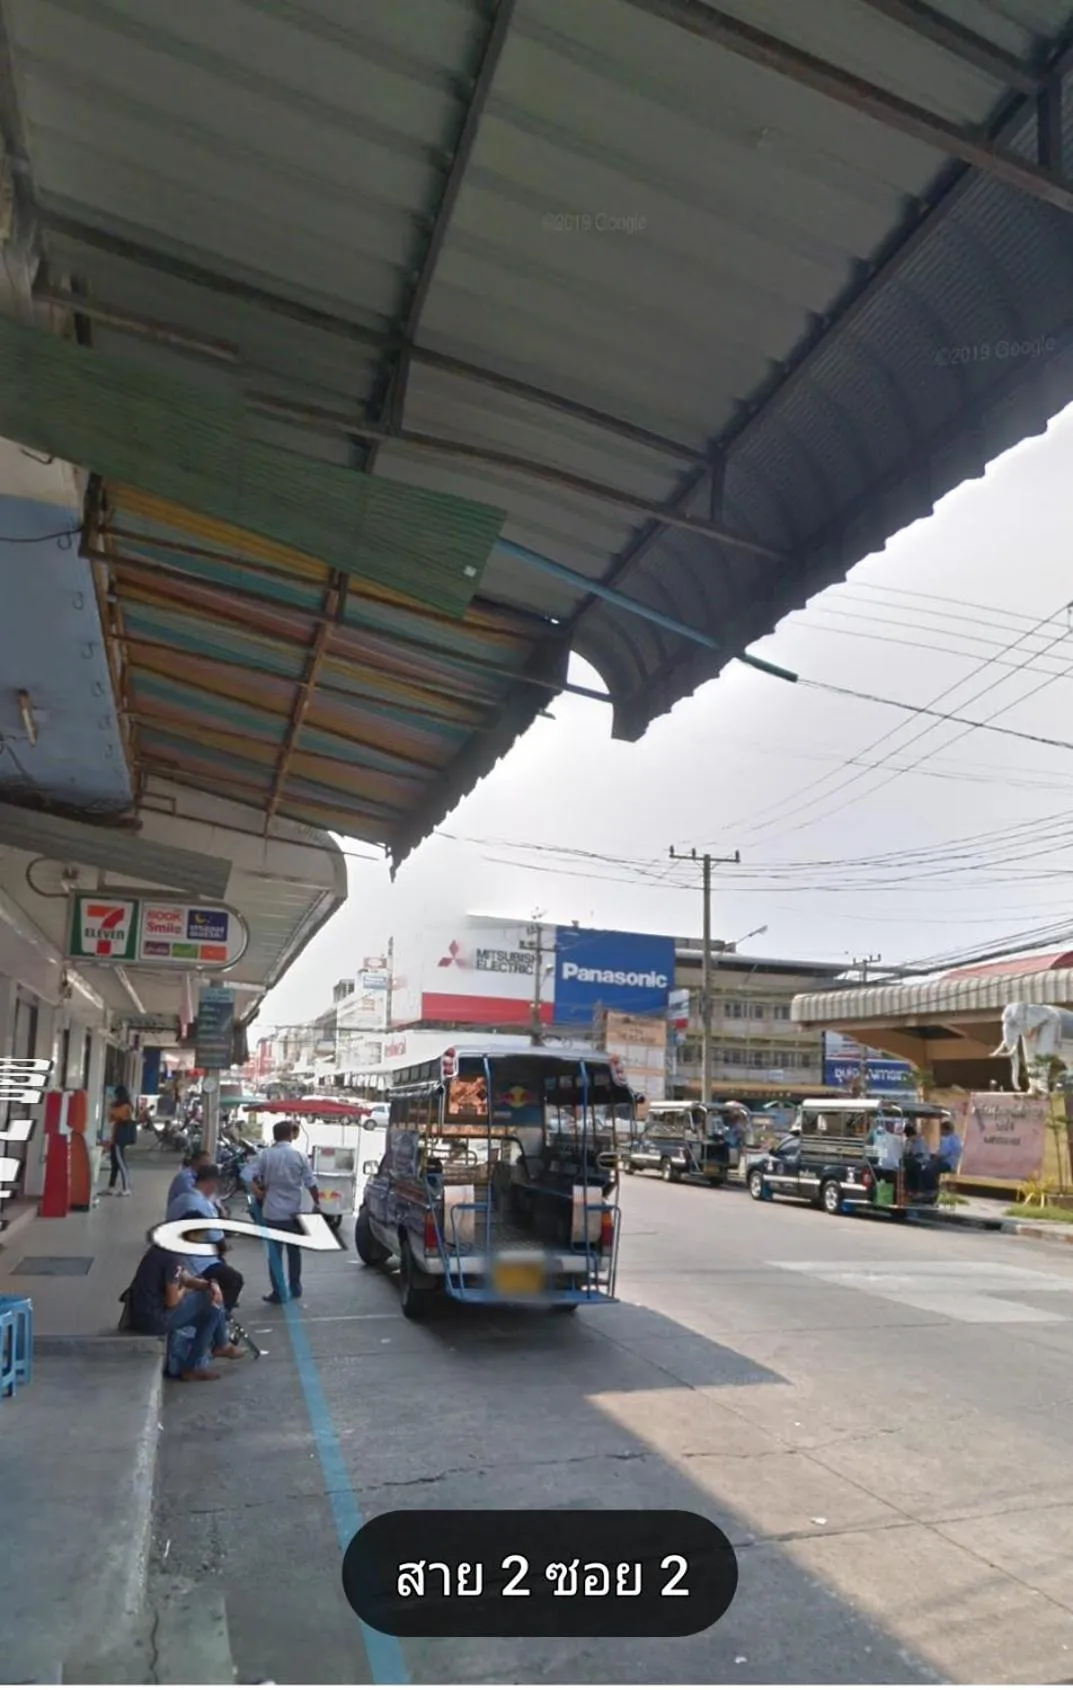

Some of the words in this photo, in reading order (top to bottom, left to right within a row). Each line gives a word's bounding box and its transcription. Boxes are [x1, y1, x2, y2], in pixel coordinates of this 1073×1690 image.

[87, 906, 125, 956] 7
[476, 959, 536, 976] ELECTRIC
[562, 961, 669, 989] Panasonic
